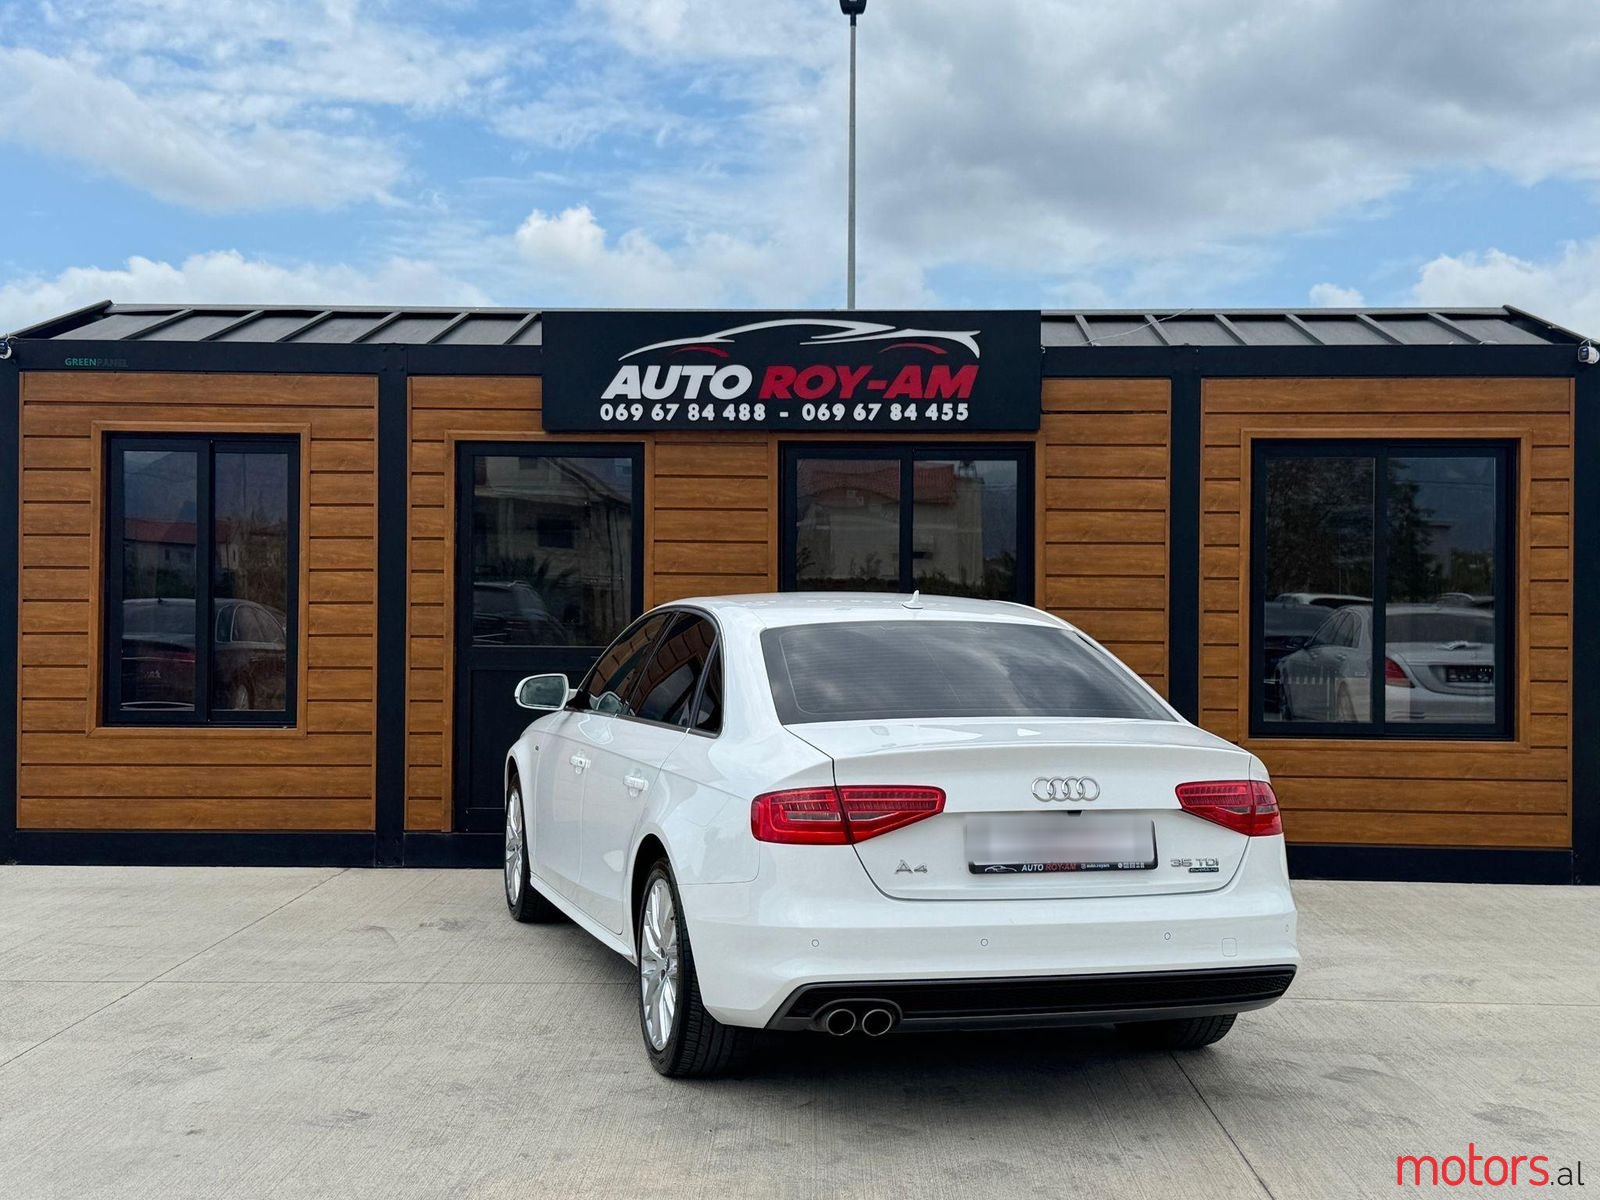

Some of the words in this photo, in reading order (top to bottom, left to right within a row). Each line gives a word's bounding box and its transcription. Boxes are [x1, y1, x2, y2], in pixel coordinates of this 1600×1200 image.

[600, 364, 753, 400] AUTO
[758, 364, 980, 399] ROY-AM
[600, 403, 643, 421] 069
[651, 403, 680, 421] 67
[687, 403, 715, 421] 84
[722, 403, 766, 421] 488
[801, 403, 846, 421] 069
[853, 403, 882, 421] 67
[889, 403, 918, 421] 84
[924, 403, 969, 421] 455
[895, 859, 928, 874] A4
[1021, 863, 1044, 872] AUTO
[1170, 858, 1193, 868] 35
[1195, 857, 1219, 867] TDI
